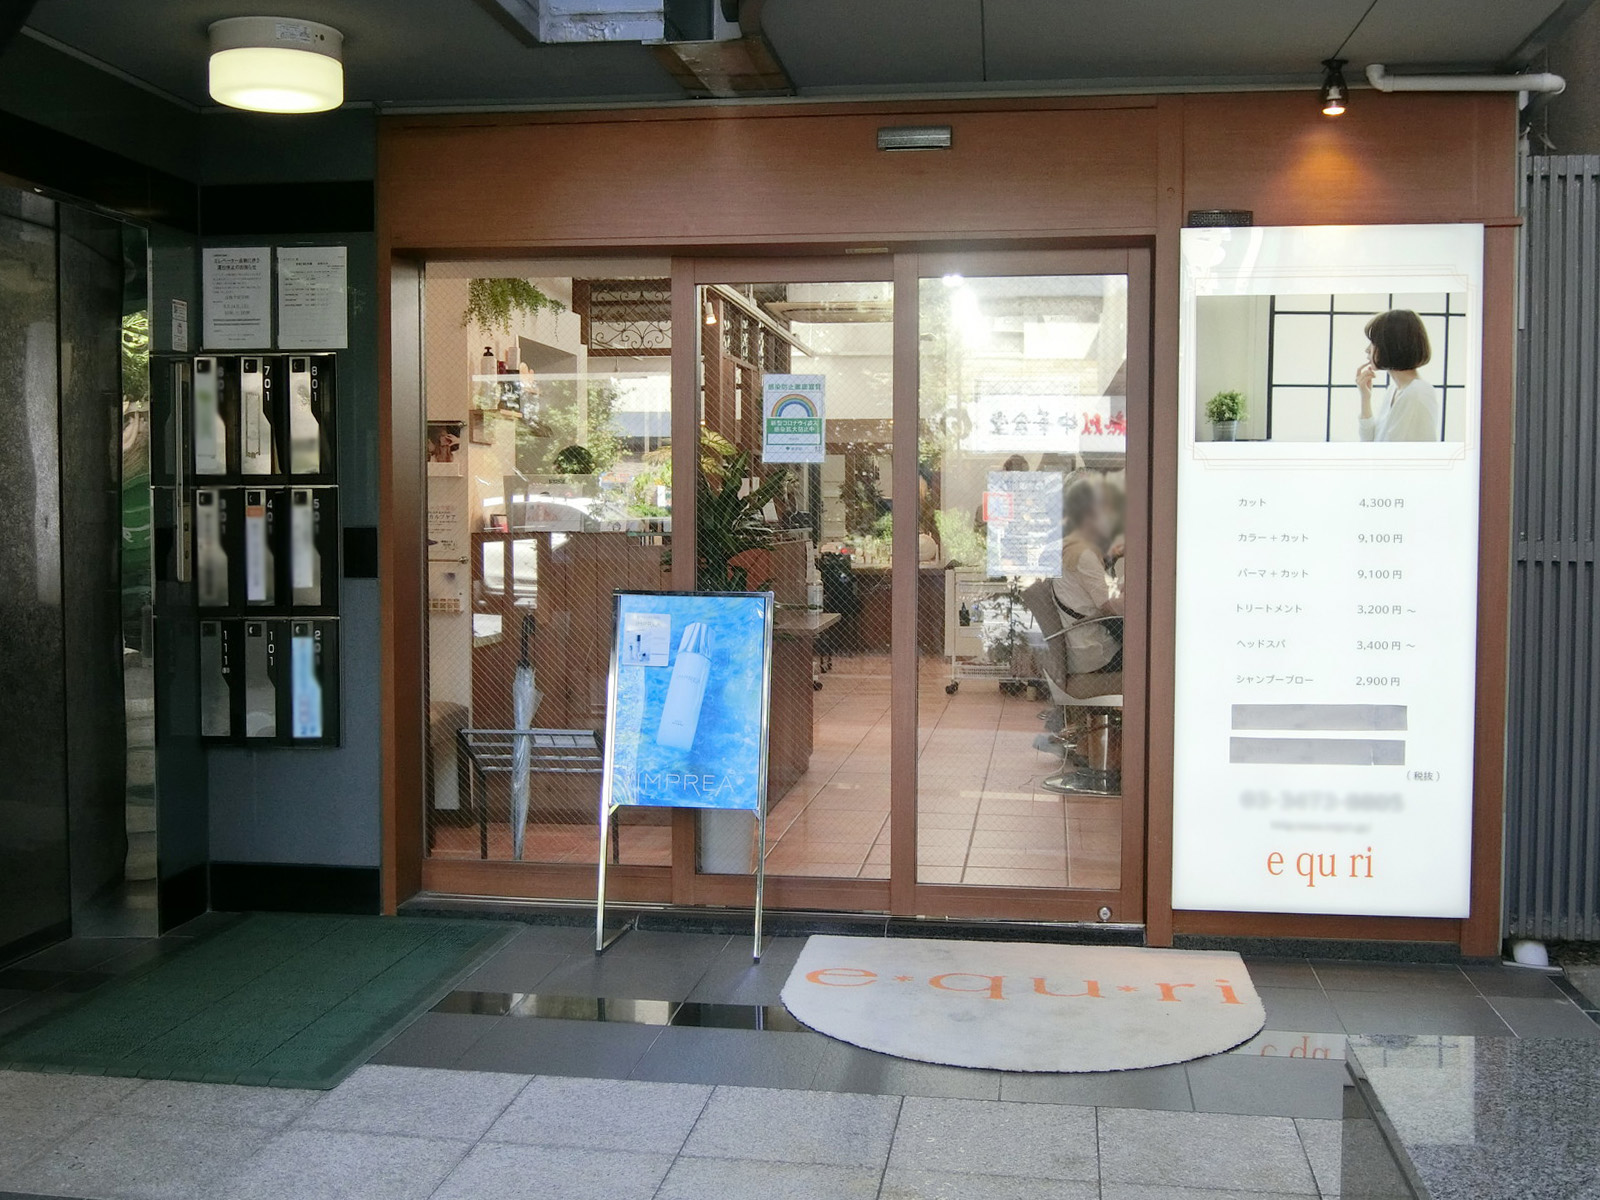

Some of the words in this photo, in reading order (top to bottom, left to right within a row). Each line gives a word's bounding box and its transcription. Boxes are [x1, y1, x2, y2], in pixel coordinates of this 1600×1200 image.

[264, 365, 272, 402] 701
[1238, 498, 1267, 508] カット
[1236, 603, 1303, 614] トリートメント
[1236, 639, 1287, 650] ヘッドスパ
[636, 773, 735, 798] IMPREA
